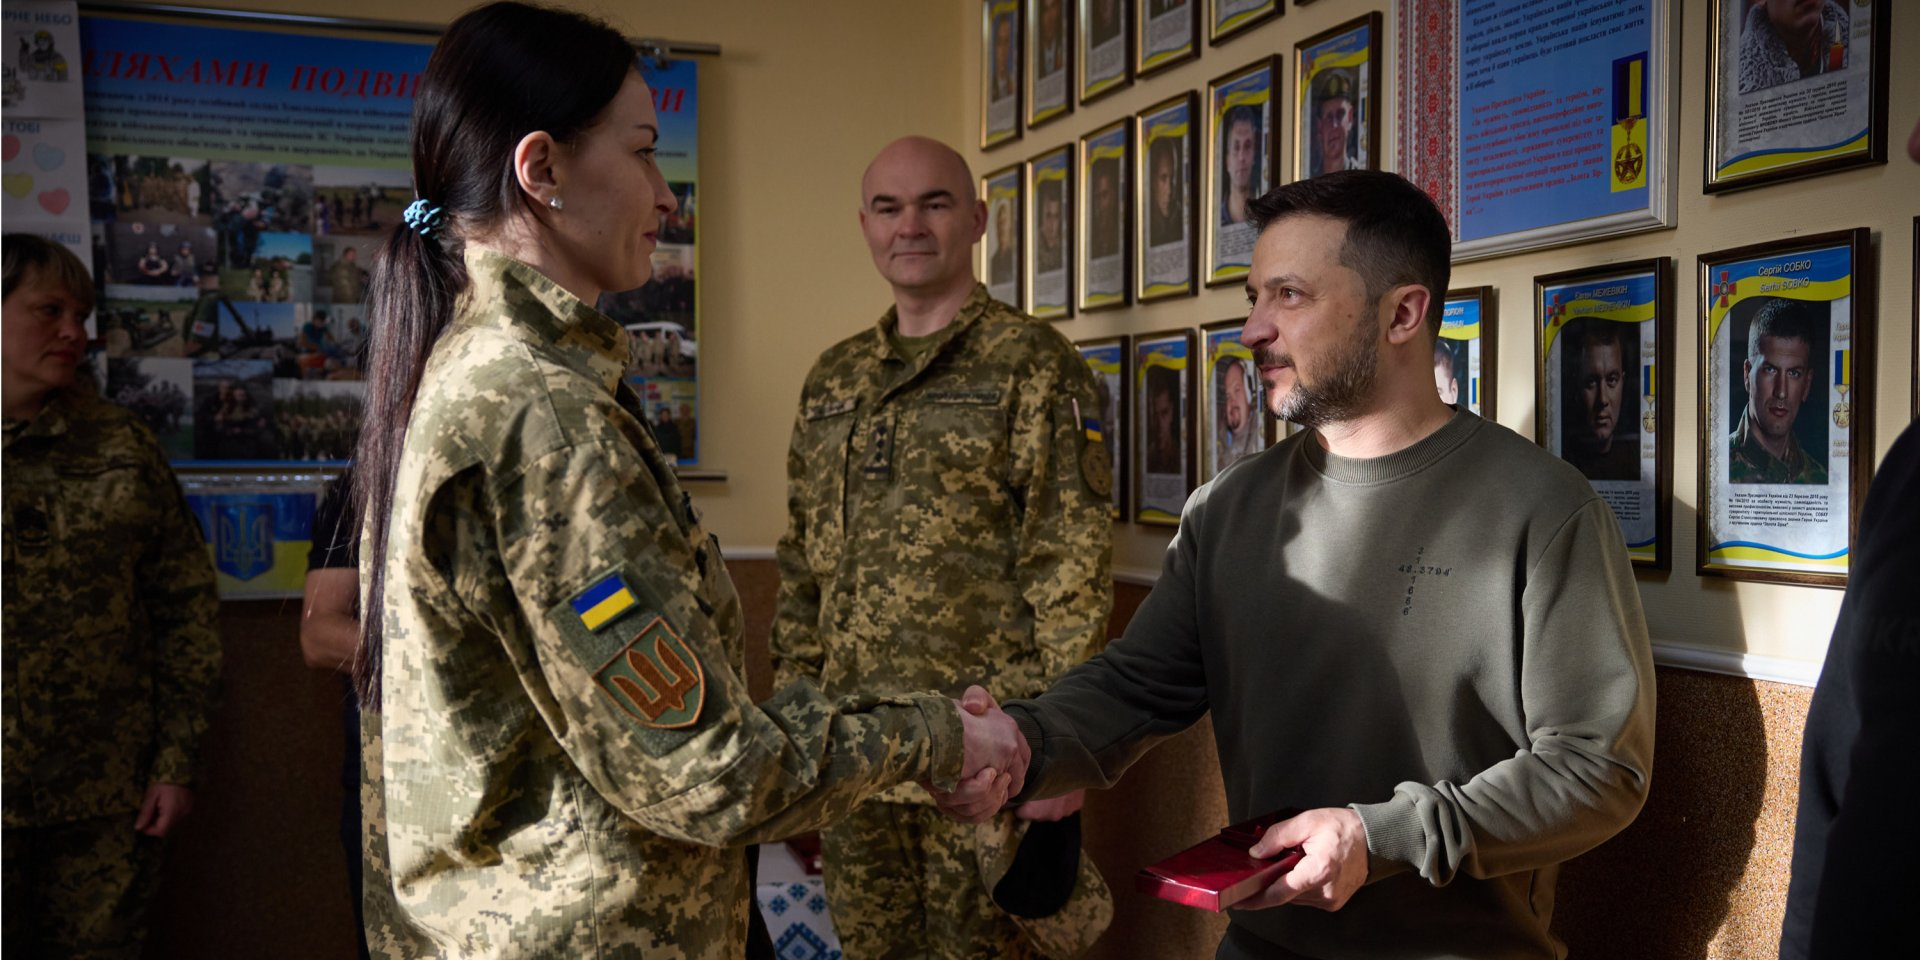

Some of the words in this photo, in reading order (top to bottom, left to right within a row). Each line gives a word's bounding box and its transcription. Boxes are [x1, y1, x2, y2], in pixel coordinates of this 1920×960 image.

[34, 13, 72, 26] НЕБО
[9, 121, 40, 134] ТОБІ
[1758, 263, 1781, 277] Сергій
[1783, 259, 1812, 273] СОБКО
